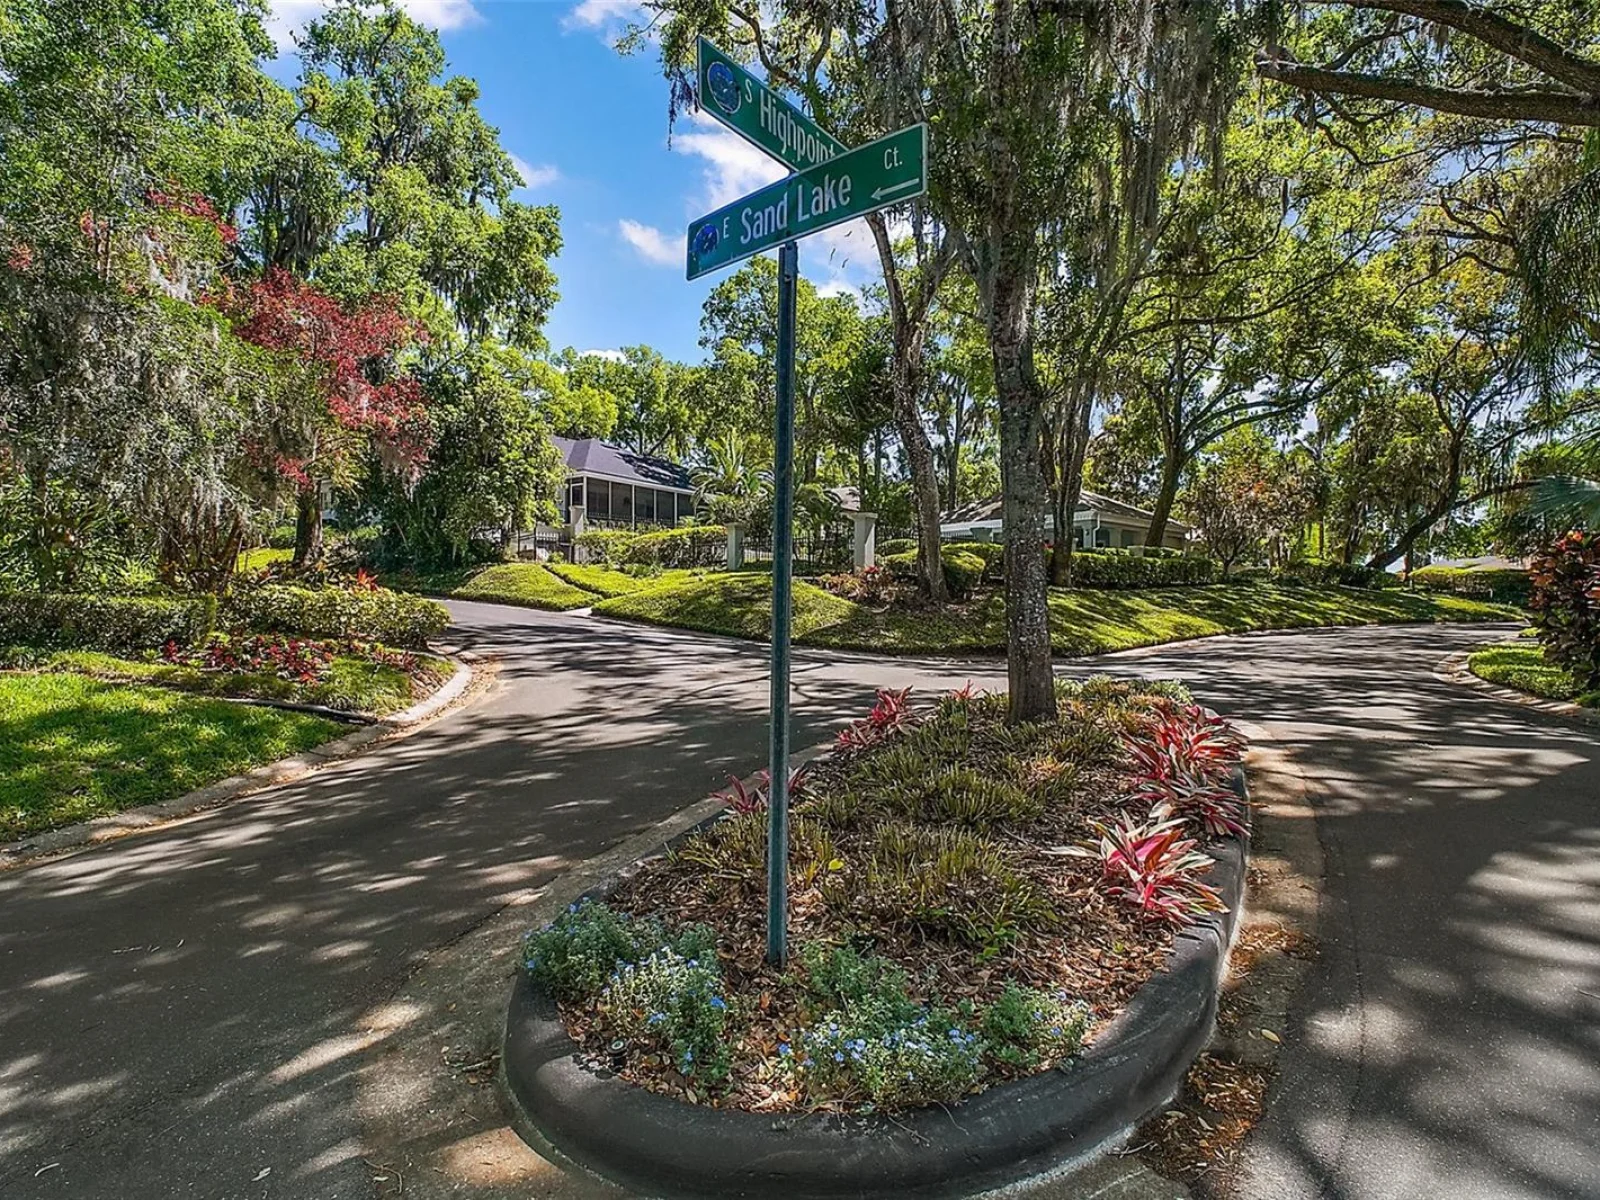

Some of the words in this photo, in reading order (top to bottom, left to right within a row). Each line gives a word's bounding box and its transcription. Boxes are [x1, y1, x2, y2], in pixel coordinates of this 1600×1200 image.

[744, 80, 753, 103] S
[884, 148, 903, 170] Ct.
[723, 216, 730, 239] E
[740, 193, 788, 244] Sand
[798, 174, 851, 222] Lake
